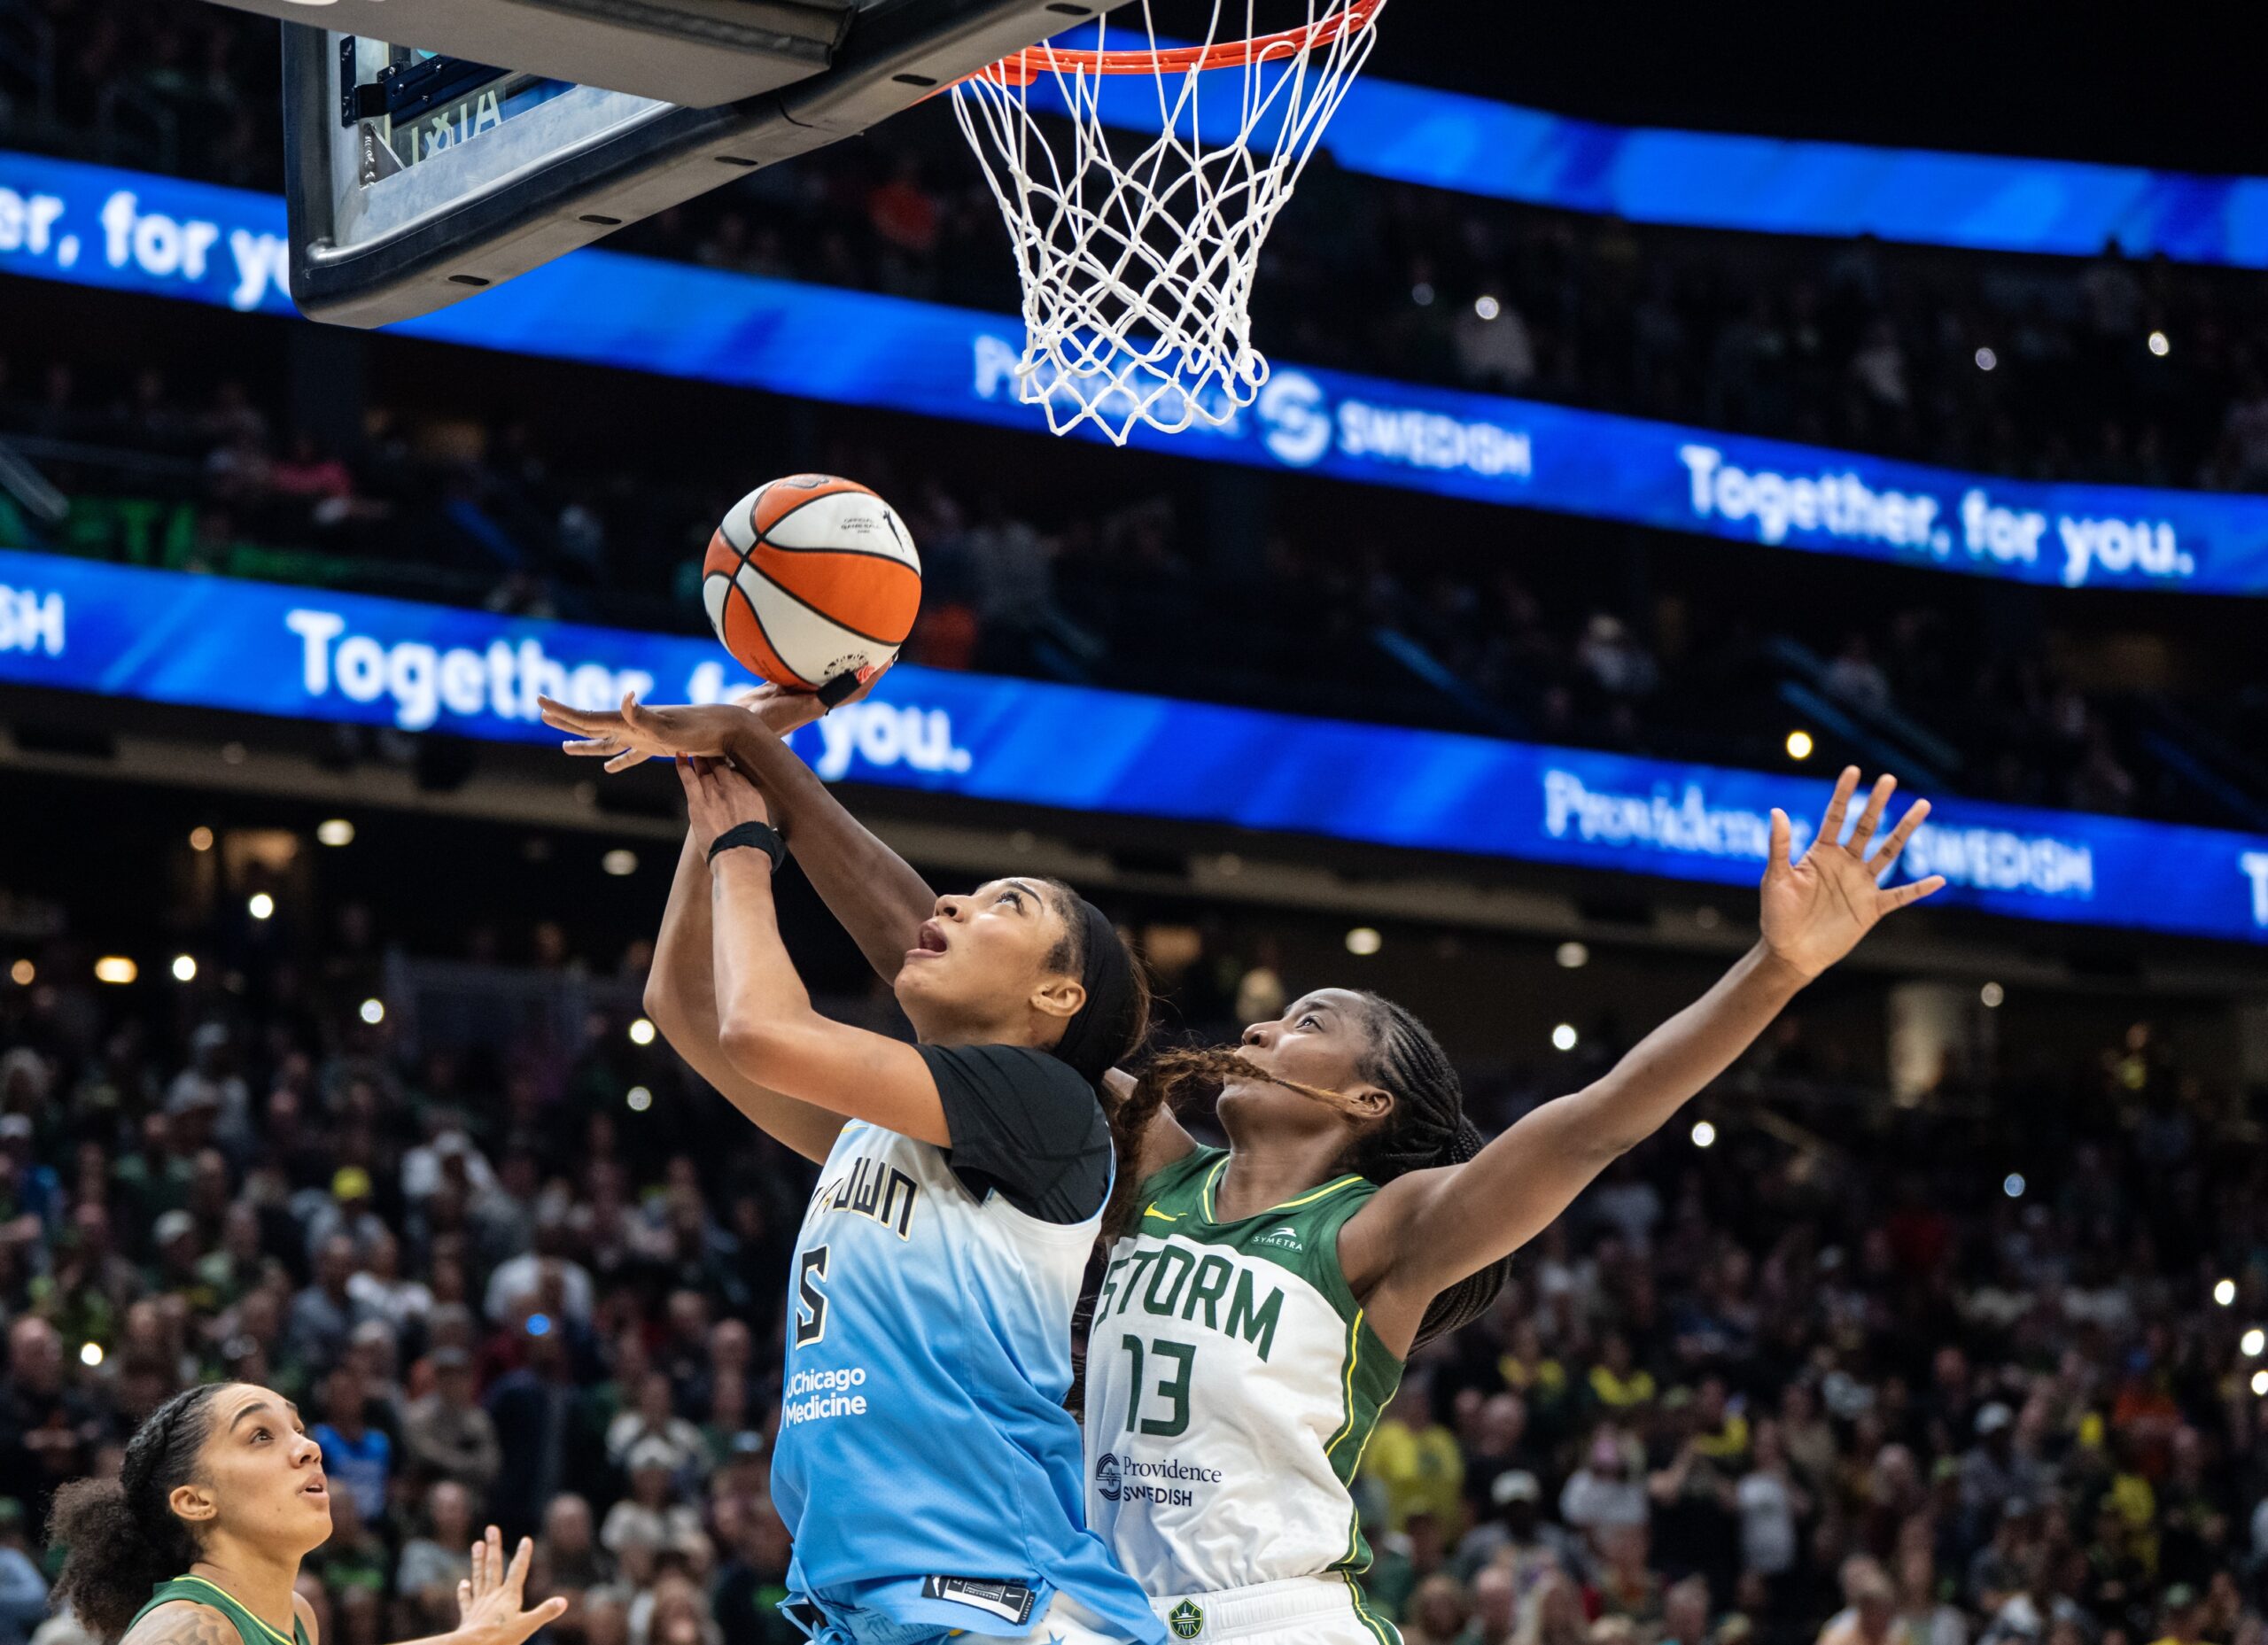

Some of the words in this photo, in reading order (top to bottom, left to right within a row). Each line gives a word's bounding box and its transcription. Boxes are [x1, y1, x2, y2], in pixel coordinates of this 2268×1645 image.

[102, 190, 219, 280] for
[1338, 400, 1531, 478] SWEDISH
[1682, 444, 1951, 562] Together,
[1961, 488, 2046, 565] for
[2059, 515, 2194, 588] you.
[816, 700, 973, 781] you.
[1544, 770, 1811, 861] Providene
[1903, 823, 2093, 898] SWEDISH
[1254, 1236, 1302, 1251] SYMETRA
[1093, 1244, 1285, 1363] STORM
[786, 1392, 867, 1429] Medicine
[1122, 1334, 1197, 1438] 13
[1122, 1455, 1222, 1483] Providence
[1122, 1486, 1192, 1507] SWEDISH
